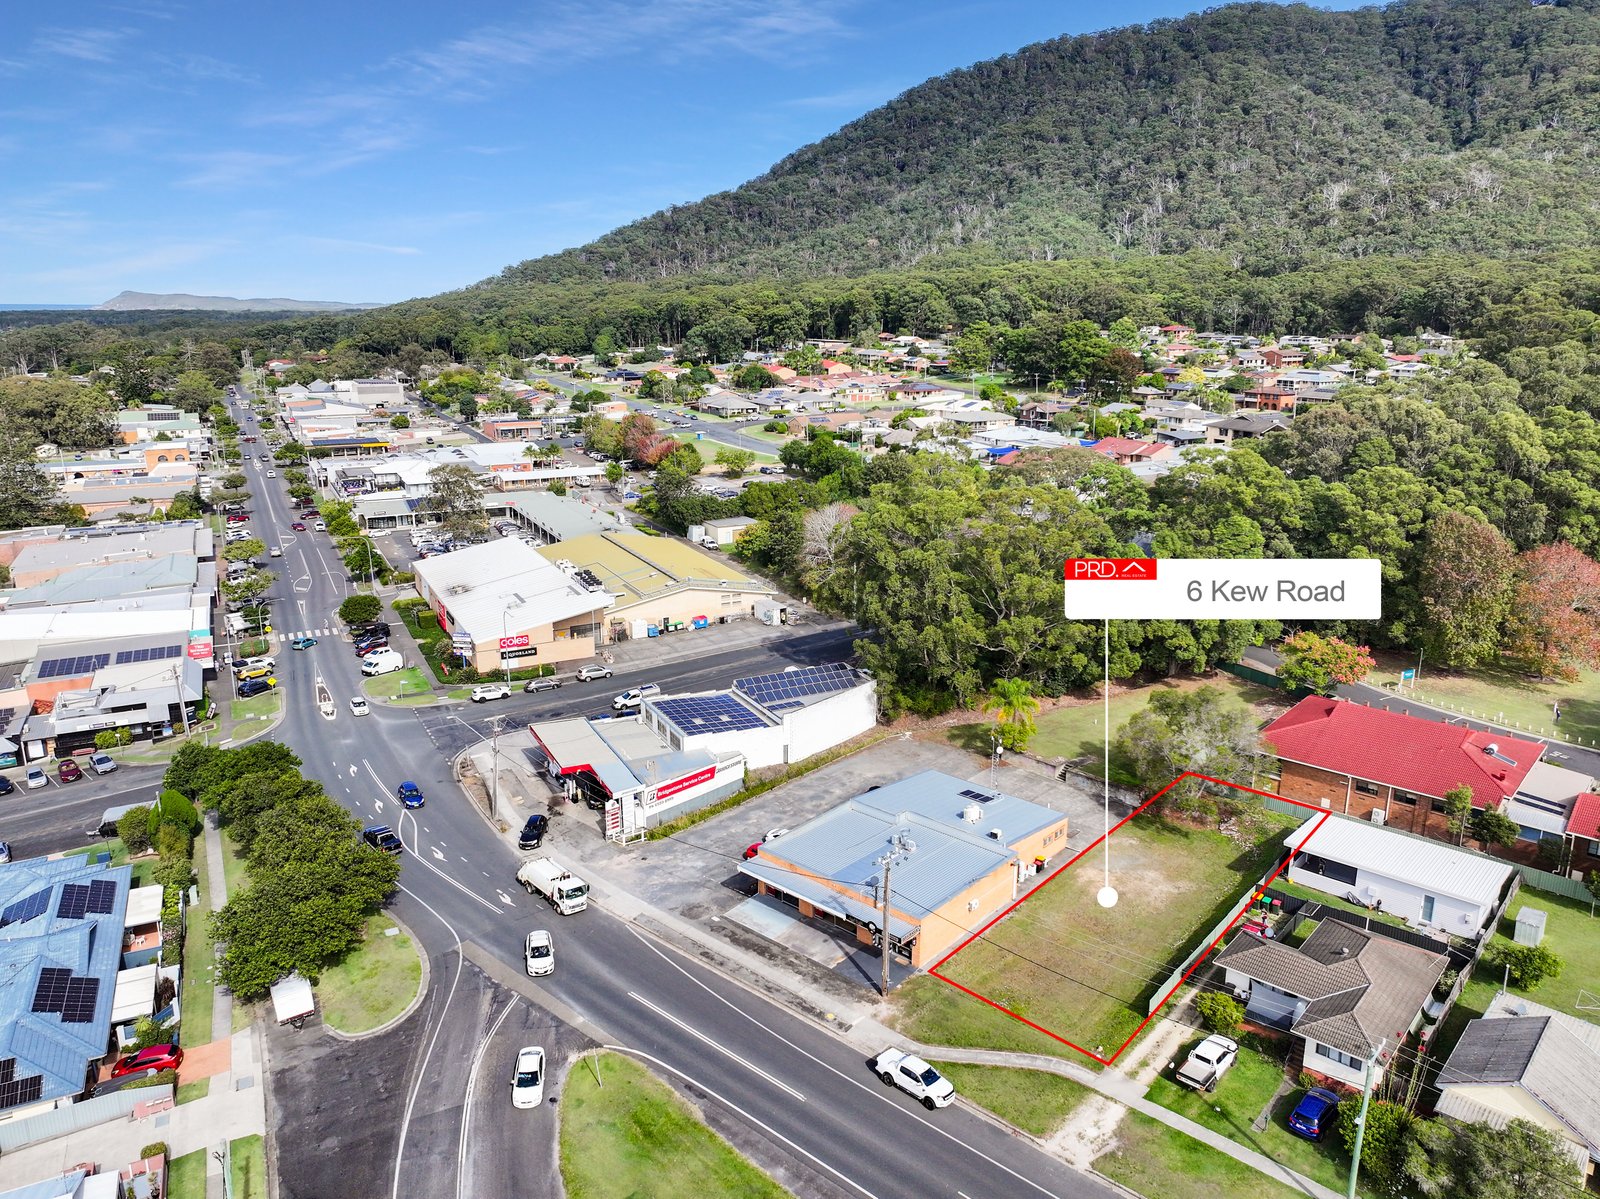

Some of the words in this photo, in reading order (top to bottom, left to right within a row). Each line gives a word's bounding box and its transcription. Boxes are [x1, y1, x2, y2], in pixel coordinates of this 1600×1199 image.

[501, 636, 528, 647] coles
[657, 785, 682, 796] Bridgestone
[683, 778, 698, 787] Service
[698, 773, 711, 782] Centre
